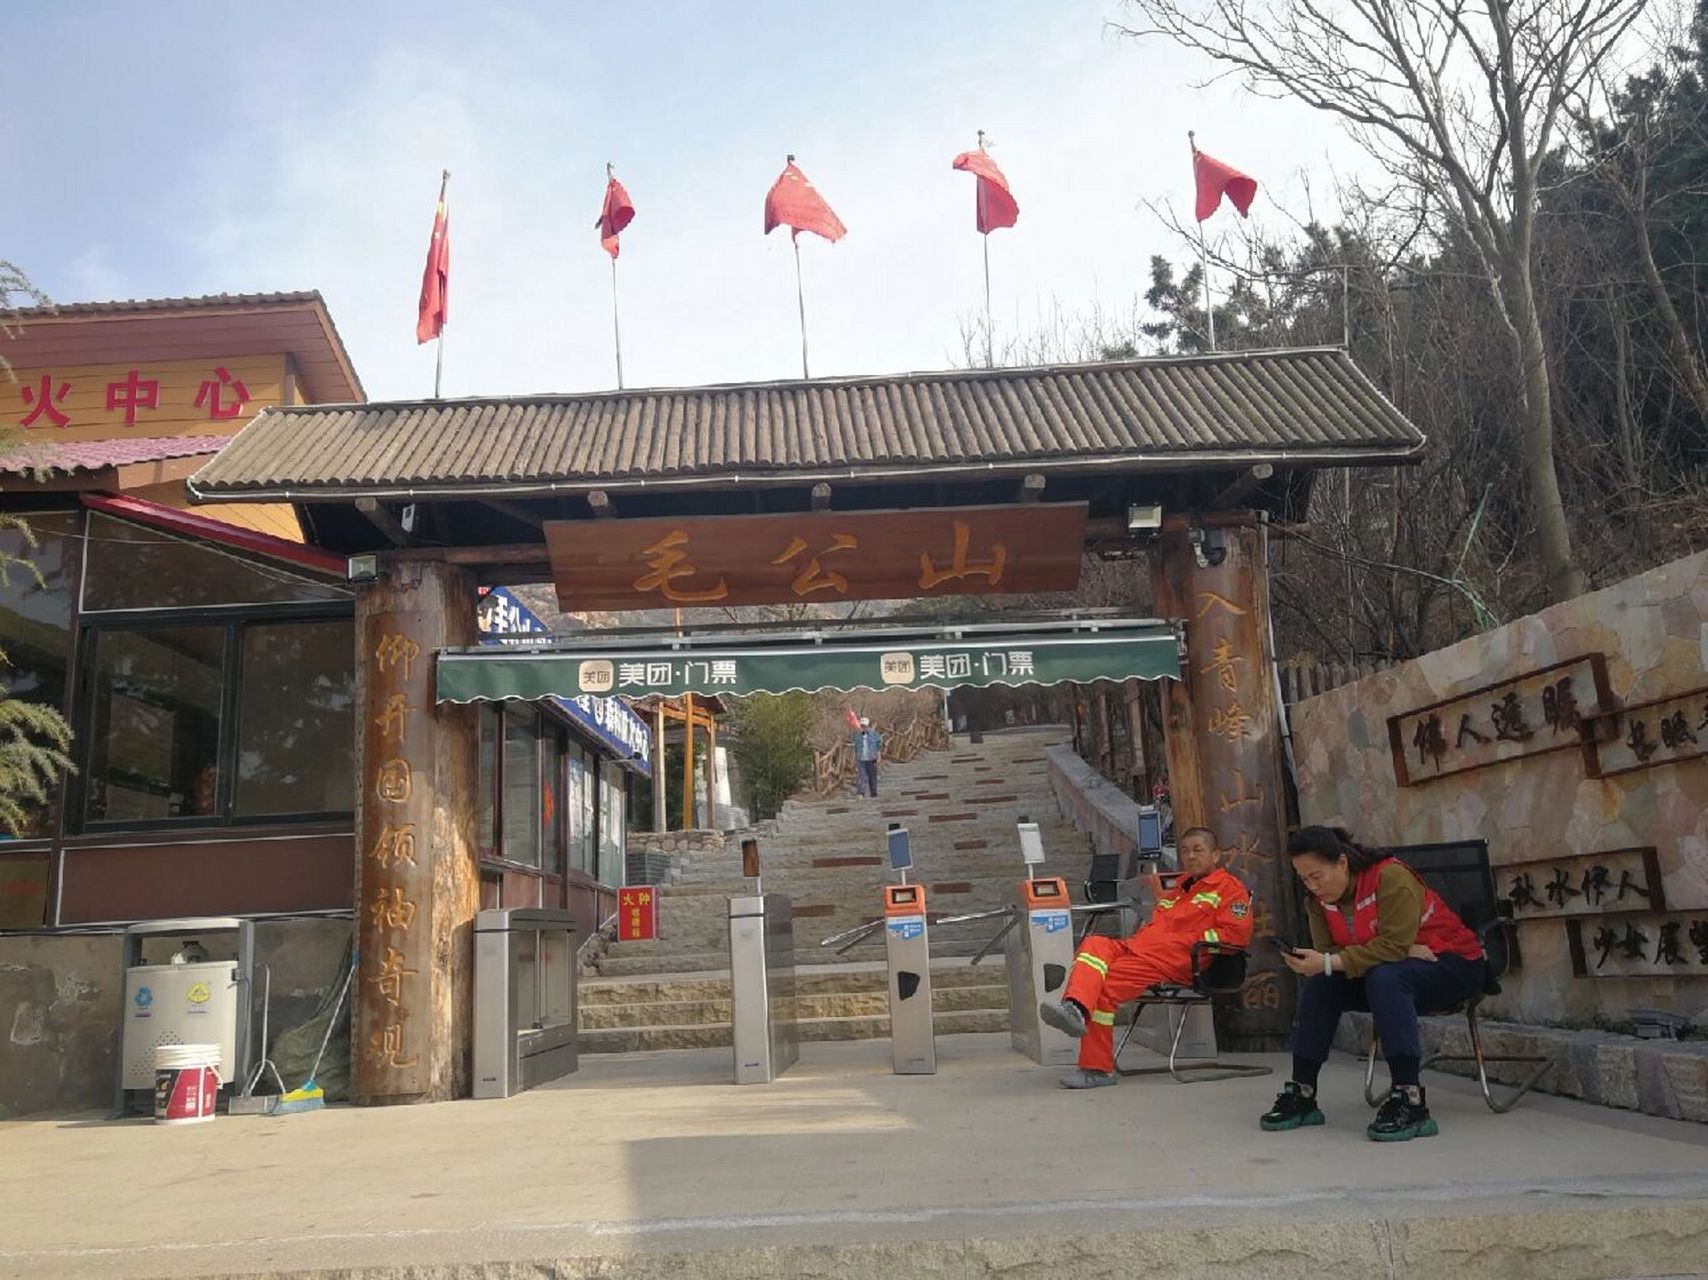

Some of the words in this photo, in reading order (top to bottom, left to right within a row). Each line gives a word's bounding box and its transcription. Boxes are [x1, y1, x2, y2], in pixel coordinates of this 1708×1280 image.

[19, 367, 252, 429] 火中心
[633, 519, 1007, 601] 毛公山
[582, 670, 611, 685] 美团
[882, 660, 911, 674] 美团
